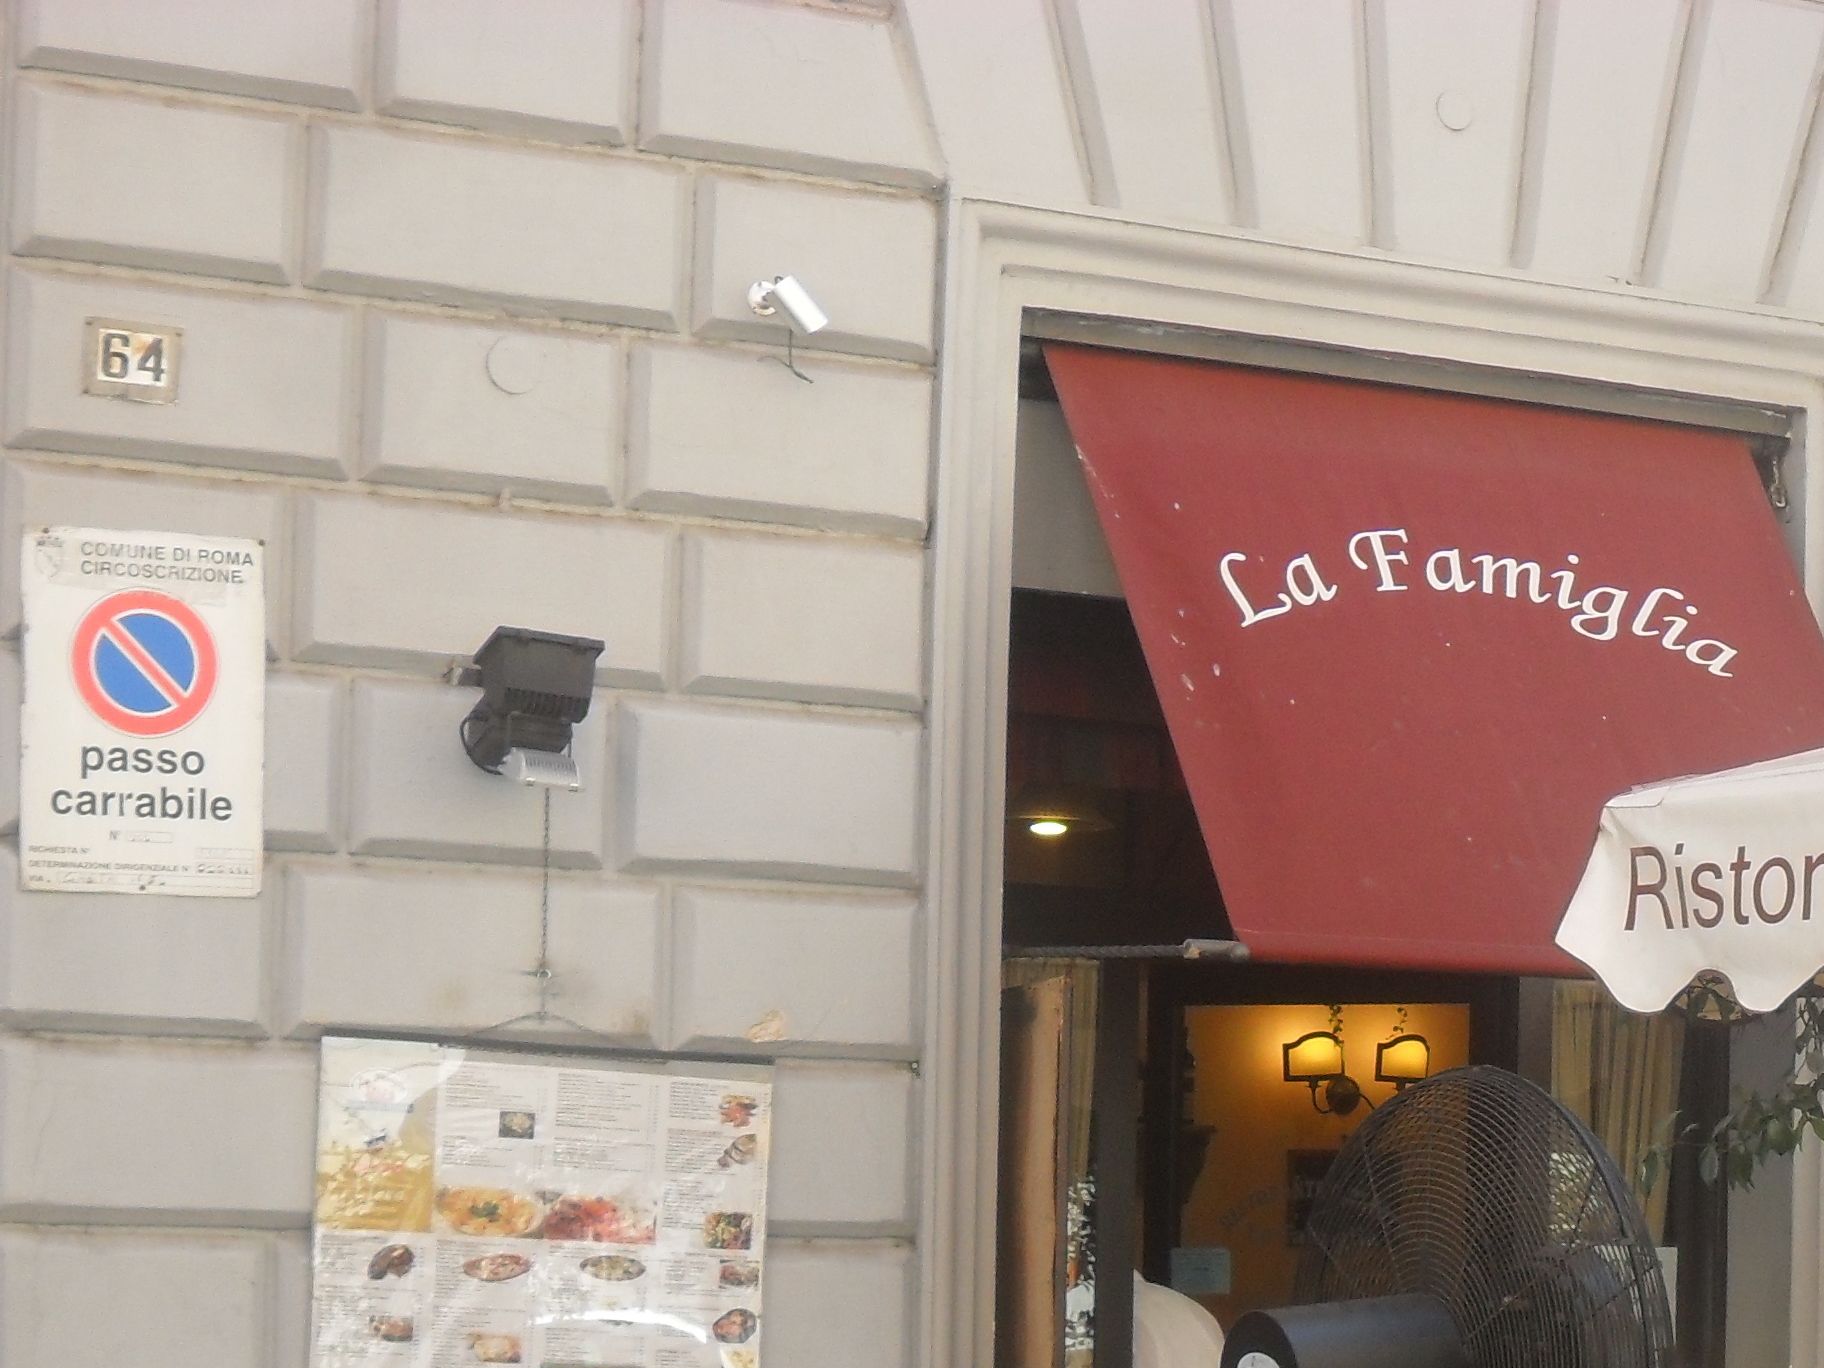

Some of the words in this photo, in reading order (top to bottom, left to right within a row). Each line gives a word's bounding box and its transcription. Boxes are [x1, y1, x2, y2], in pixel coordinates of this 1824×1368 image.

[102, 333, 165, 382] 64
[80, 541, 166, 562] COMUNE
[172, 547, 191, 563] DI
[197, 548, 255, 566] ROMA
[80, 560, 244, 585] CIRCOSCRIZIONE
[1219, 551, 1338, 629] La
[1348, 528, 1738, 678] Famiglia
[80, 745, 206, 780] passo
[50, 786, 233, 822] carrabile
